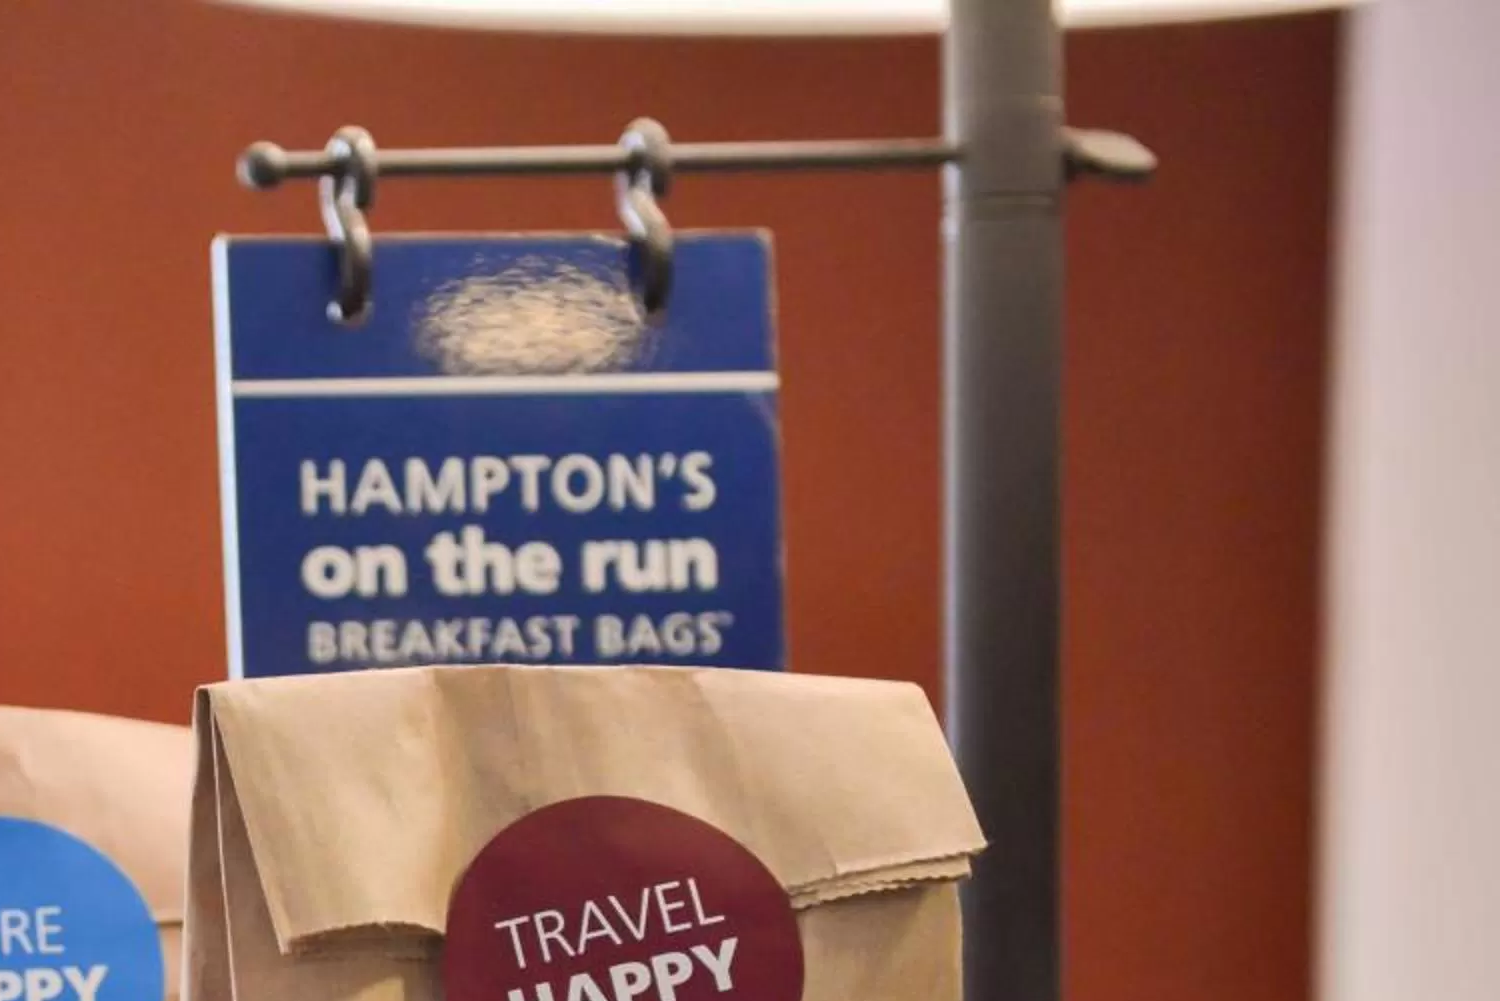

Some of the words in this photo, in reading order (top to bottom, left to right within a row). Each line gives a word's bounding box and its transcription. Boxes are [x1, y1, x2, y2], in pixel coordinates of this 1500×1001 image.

[300, 450, 717, 516] HAMPTON'S
[302, 543, 407, 598] on
[426, 524, 562, 595] the
[581, 535, 718, 593] run
[307, 615, 580, 664] BREAKFAST
[494, 876, 726, 970] TRAVEL
